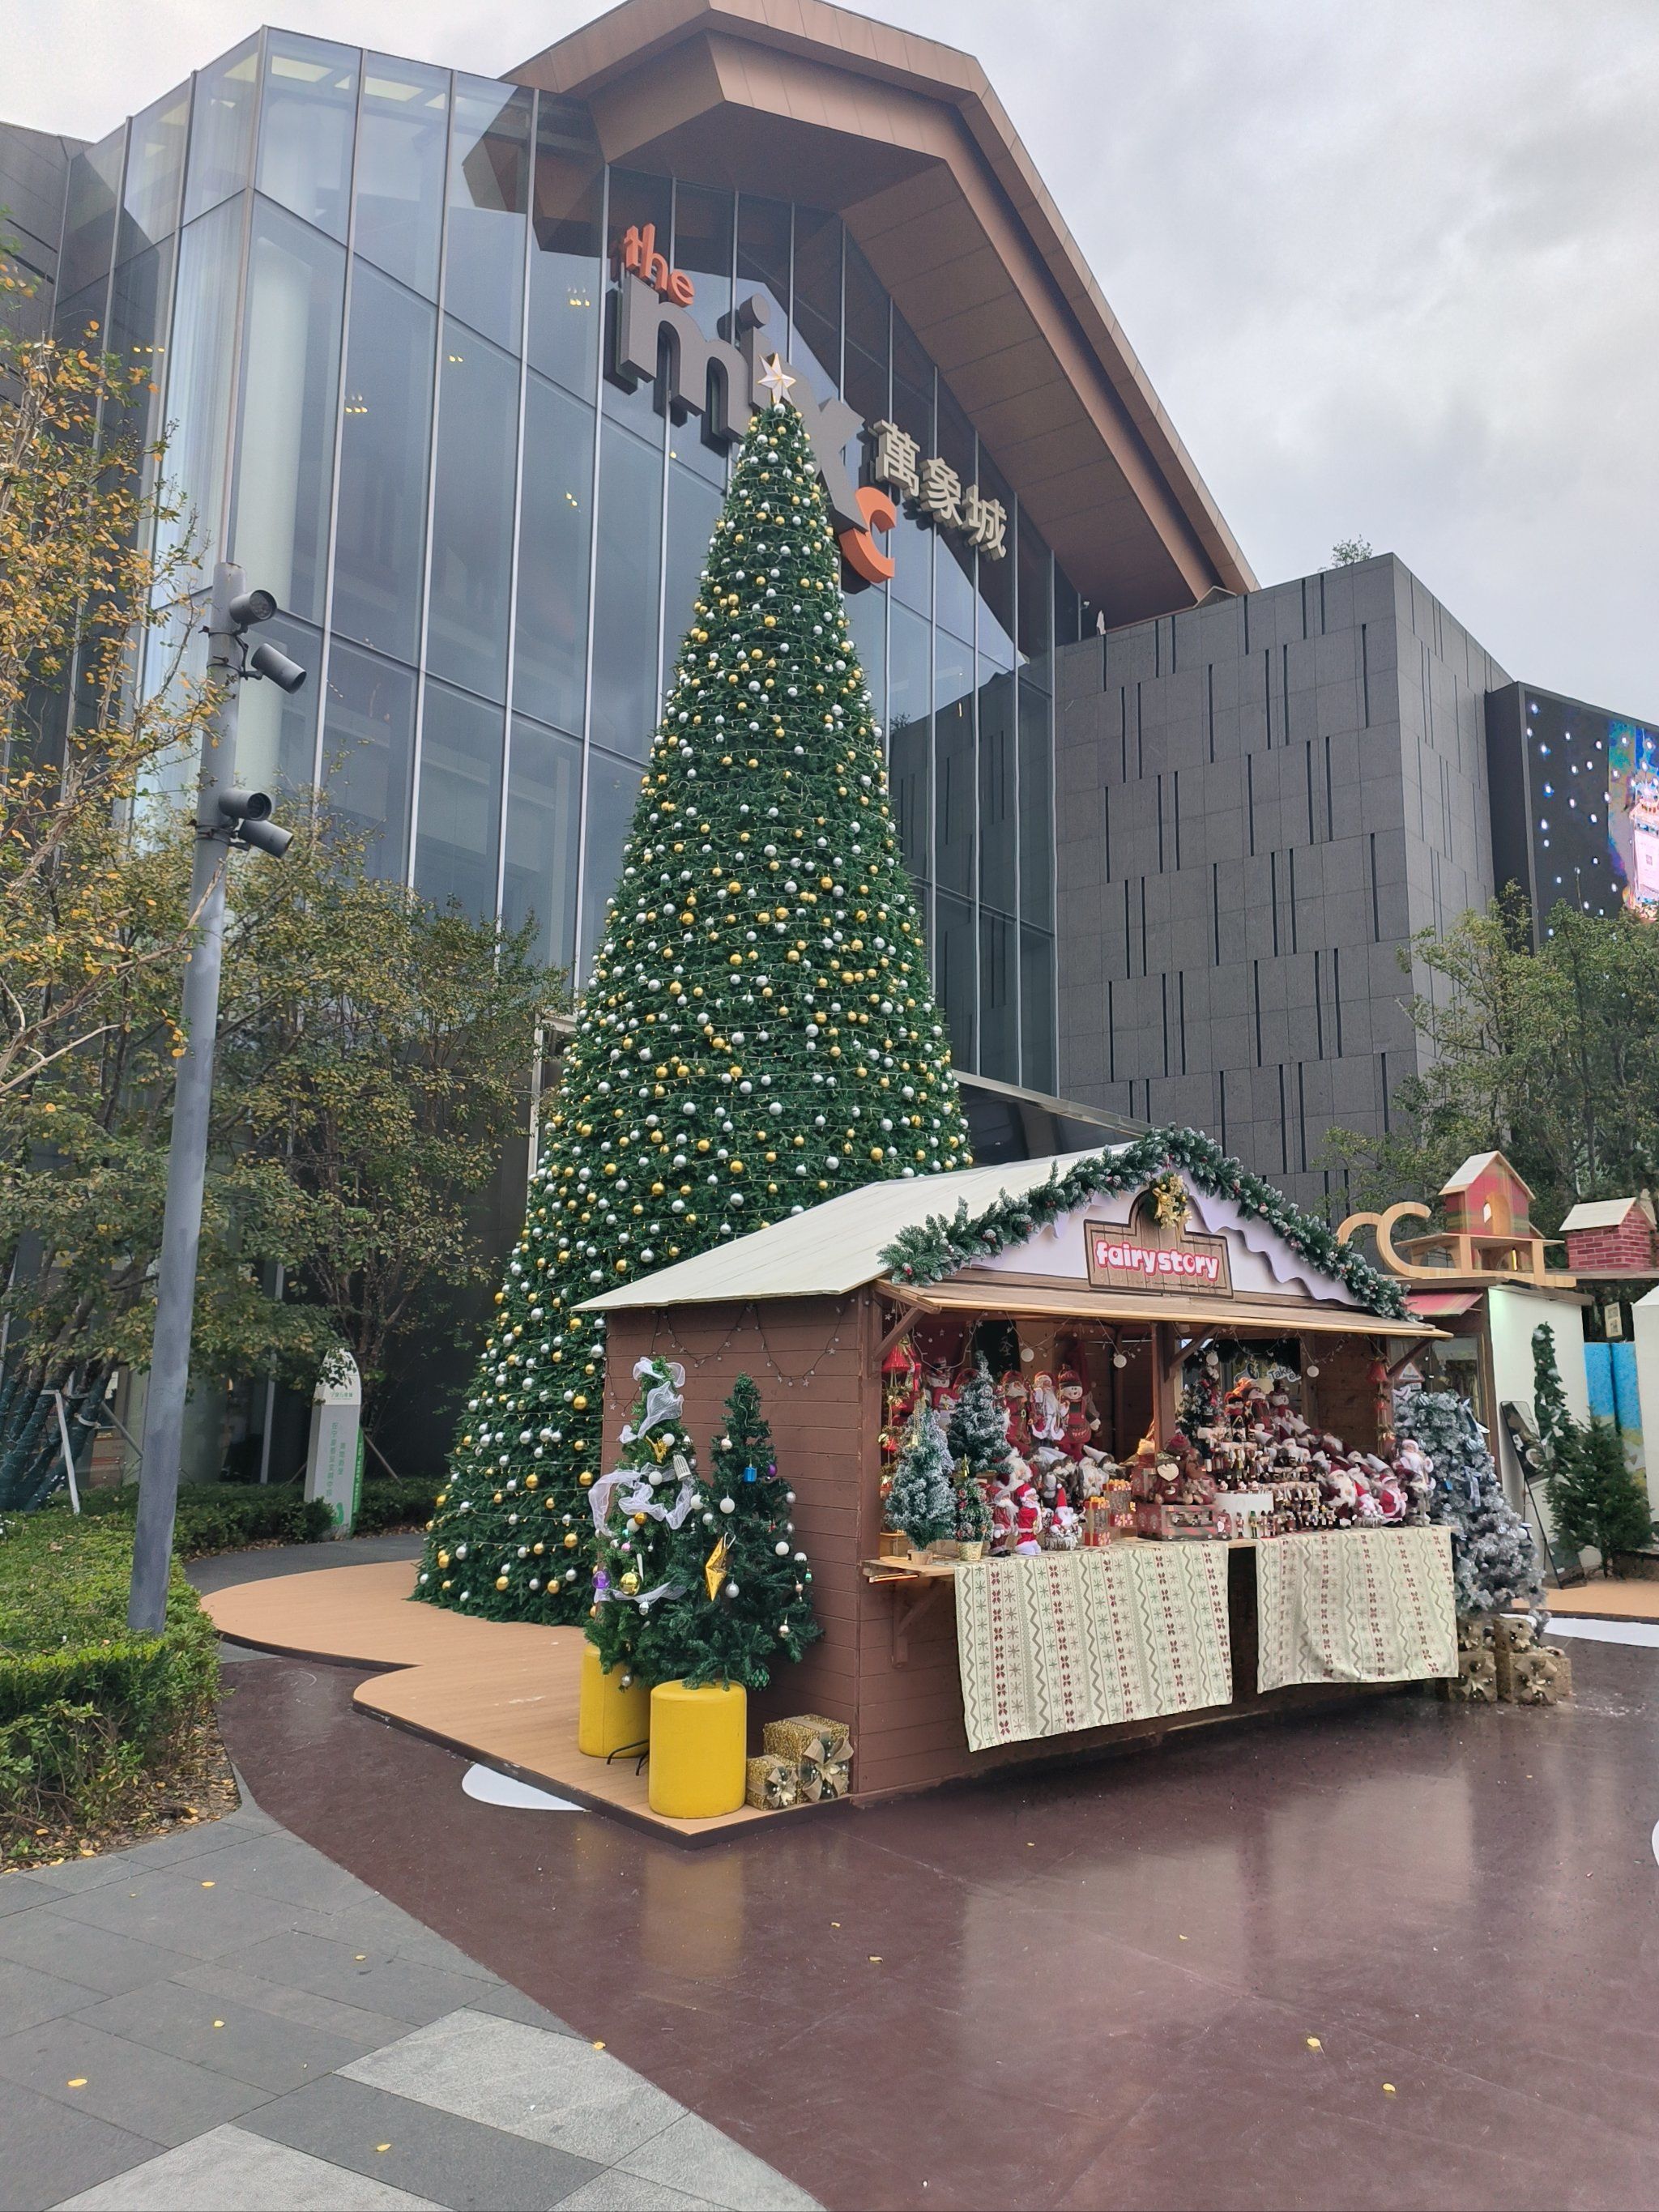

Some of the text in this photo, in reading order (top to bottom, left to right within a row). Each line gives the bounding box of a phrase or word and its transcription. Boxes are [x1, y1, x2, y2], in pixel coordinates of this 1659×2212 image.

[622, 223, 694, 308] the
[874, 419, 1008, 561] 萬象城
[1095, 1240, 1220, 1282] fairystory
